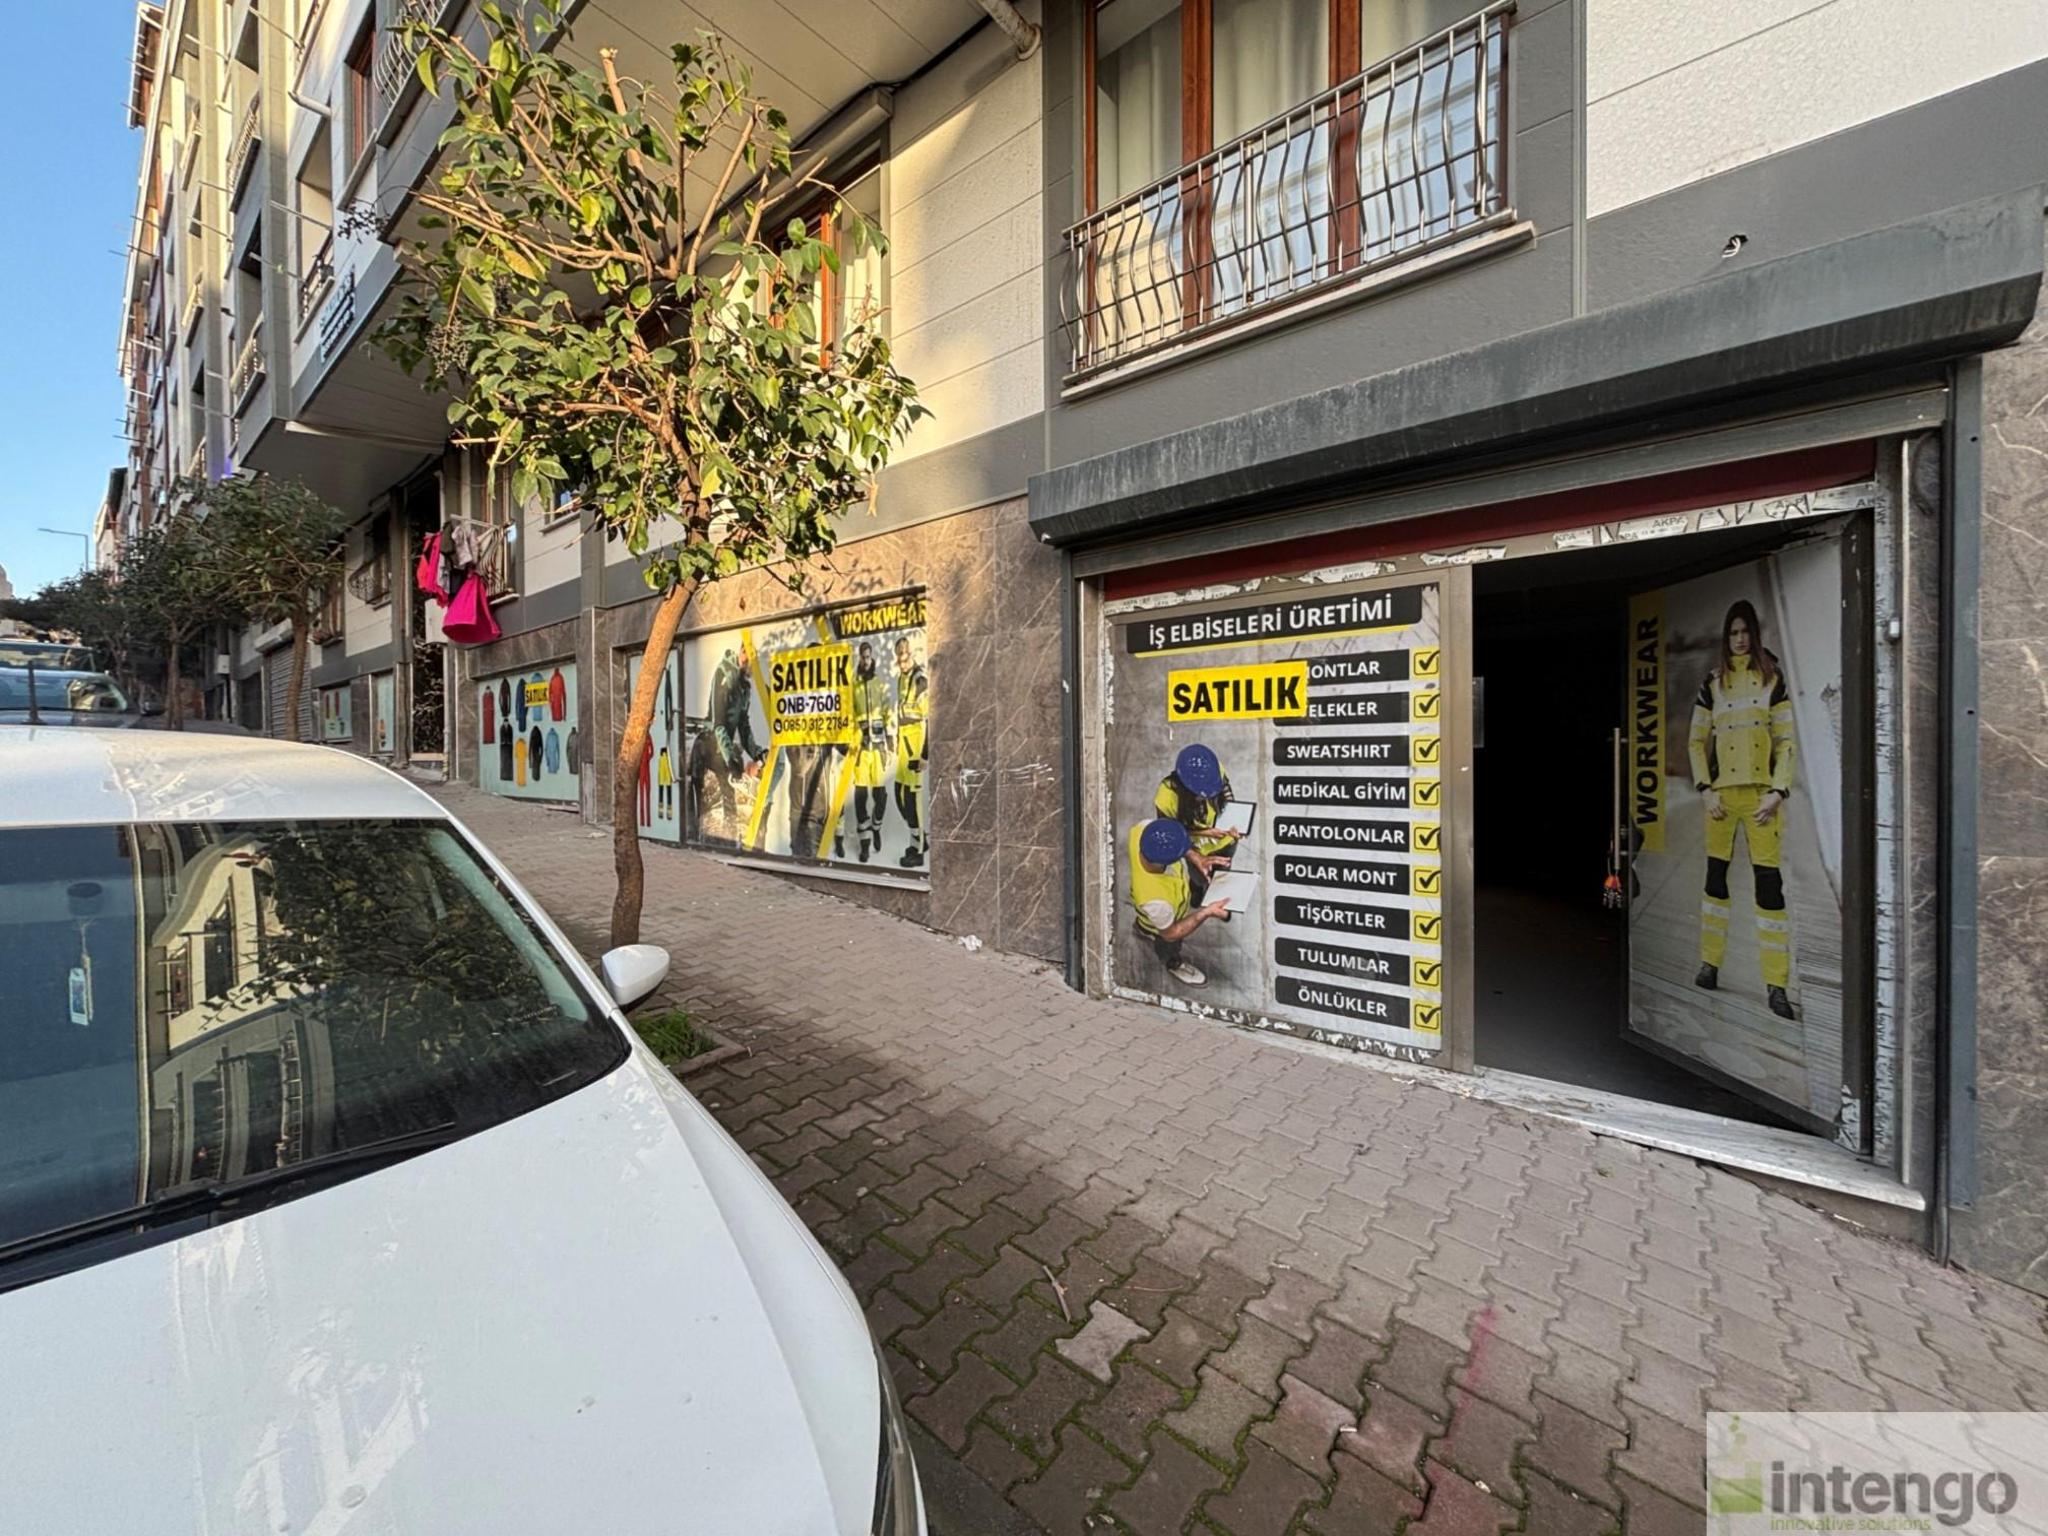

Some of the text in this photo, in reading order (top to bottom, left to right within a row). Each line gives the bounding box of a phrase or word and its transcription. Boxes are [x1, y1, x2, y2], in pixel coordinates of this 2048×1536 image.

[841, 600, 927, 635] WORKWEAR
[1149, 593, 1393, 650] İŞ ELBİSELERİ ÜRETİMİ
[772, 654, 849, 693] SATILIK
[1306, 660, 1380, 679] ONTLAR
[776, 694, 842, 714] ONB-7608
[1173, 675, 1301, 715] SATILIK
[1308, 702, 1378, 717] ELEKLER
[1637, 616, 1659, 825] WORKWEAR
[1287, 744, 1392, 759] SWEATSHIRT
[1278, 780, 1406, 801] MEDİKAL GİYİM
[1278, 823, 1405, 844] PANTOLONLAR
[1285, 863, 1398, 887] POLAR MONT
[1297, 903, 1386, 929] TİŞÖRTLER
[1297, 948, 1390, 975] TULUMLAR
[1298, 985, 1388, 1017] ÖNLÜKLER
